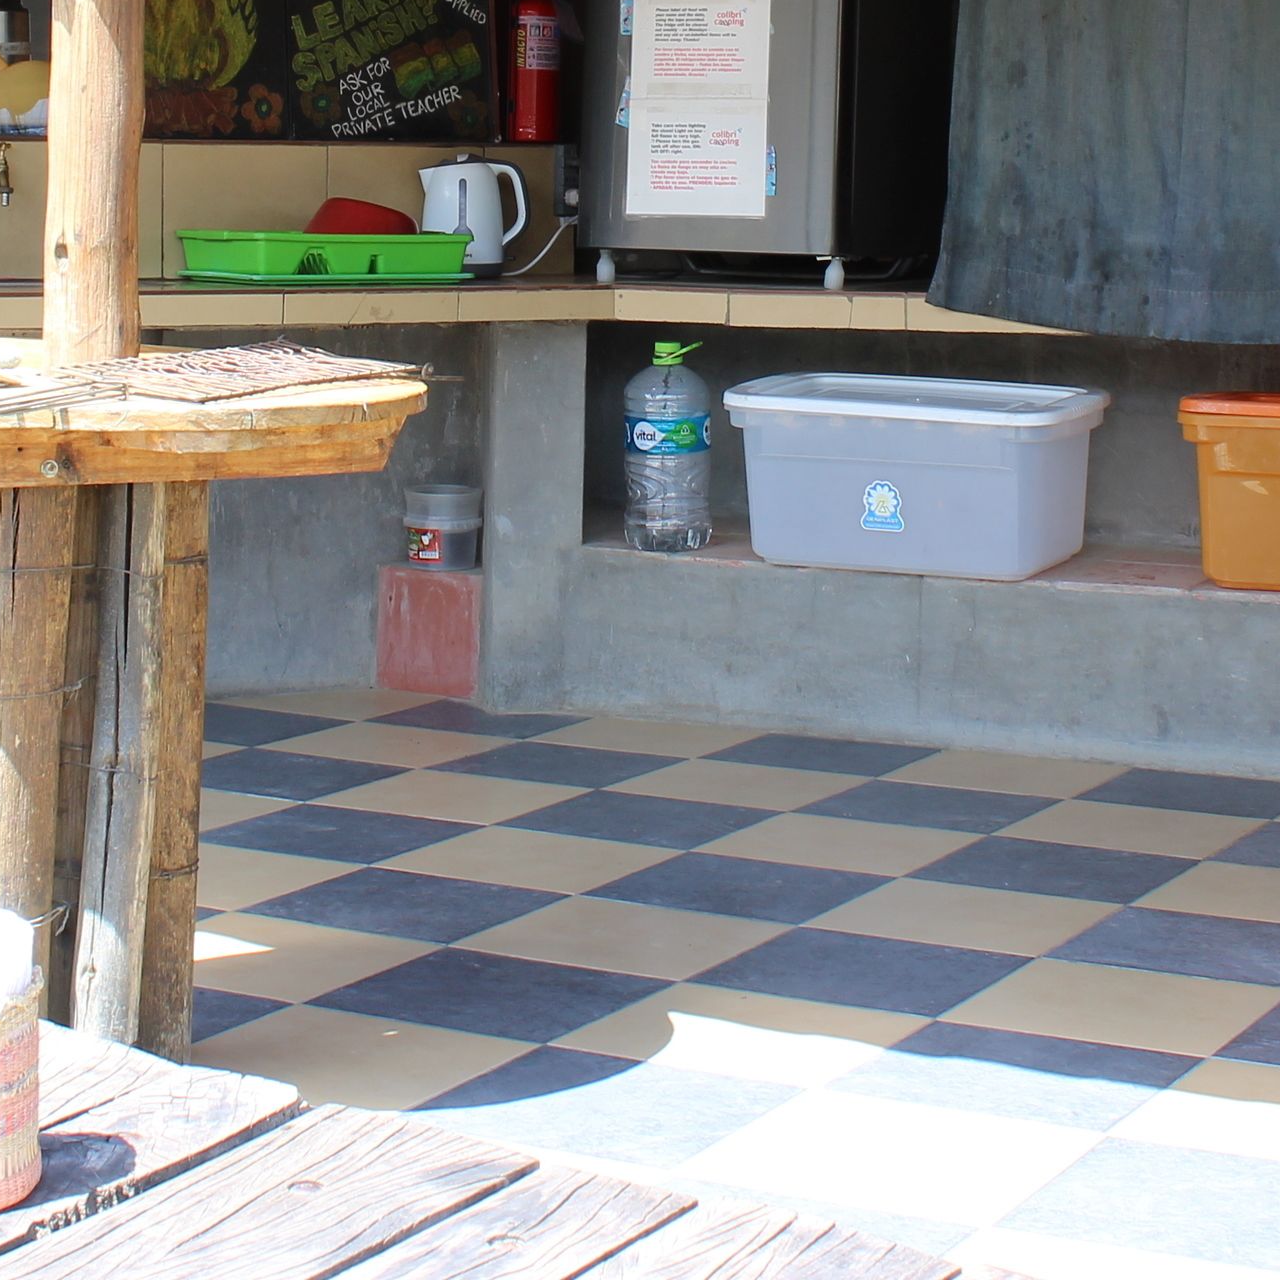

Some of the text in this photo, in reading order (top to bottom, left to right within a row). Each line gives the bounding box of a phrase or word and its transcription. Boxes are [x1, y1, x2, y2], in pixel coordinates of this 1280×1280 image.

[517, 30, 526, 68] INTACTO
[339, 57, 391, 95] ASK FOR
[352, 82, 384, 106] OUR
[395, 85, 462, 119] TEACHER
[348, 95, 390, 121] LOCAL
[712, 130, 736, 138] colibri
[636, 429, 656, 440] vital
